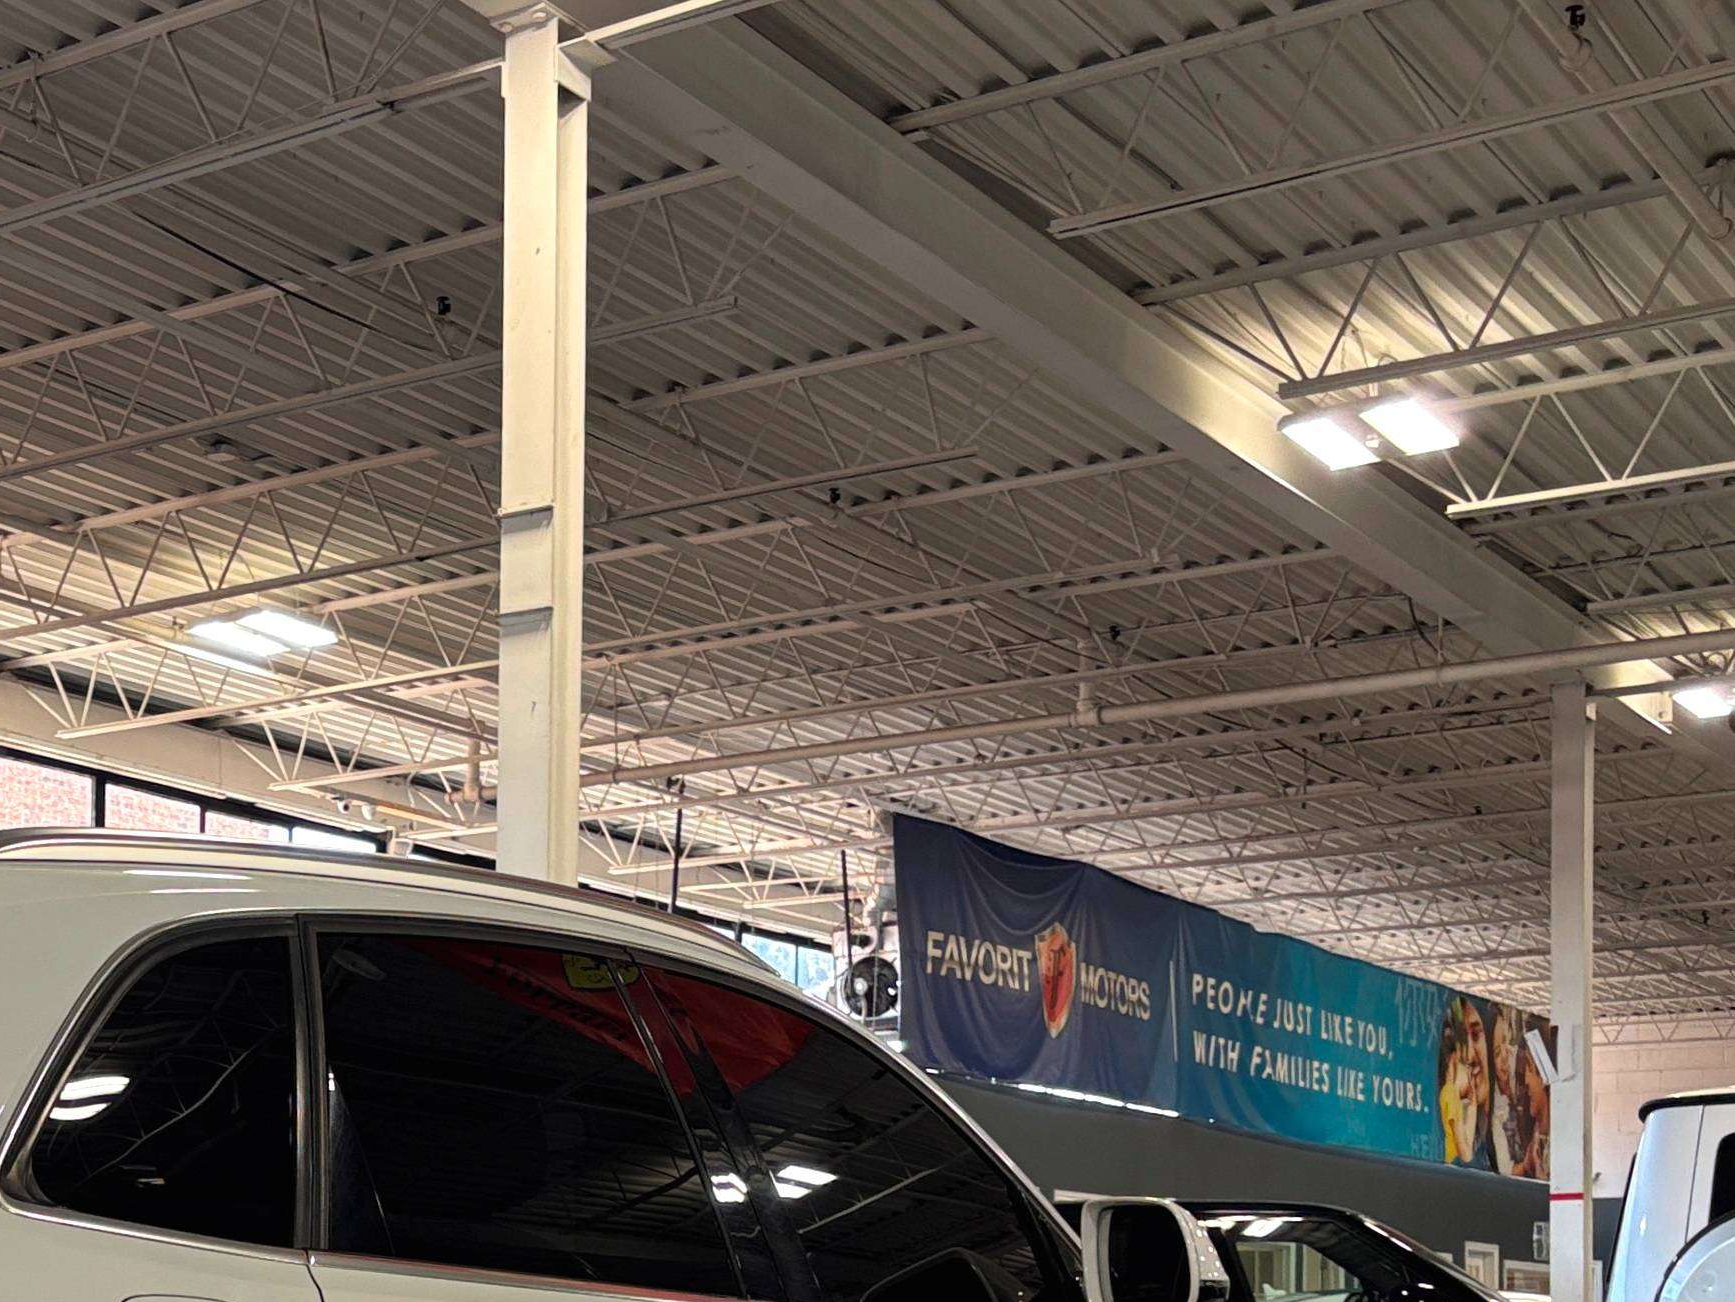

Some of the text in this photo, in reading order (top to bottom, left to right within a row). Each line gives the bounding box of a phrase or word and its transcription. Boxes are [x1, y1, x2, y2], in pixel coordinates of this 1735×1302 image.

[925, 930, 1151, 1021] FAVORIT MOTORS
[1273, 998, 1313, 1036] JUST
[1321, 1009, 1353, 1046] LIKE
[1356, 1020, 1394, 1060] YOU,
[1193, 1030, 1429, 1114] WITH FAMILIES LIKE YOURS.
